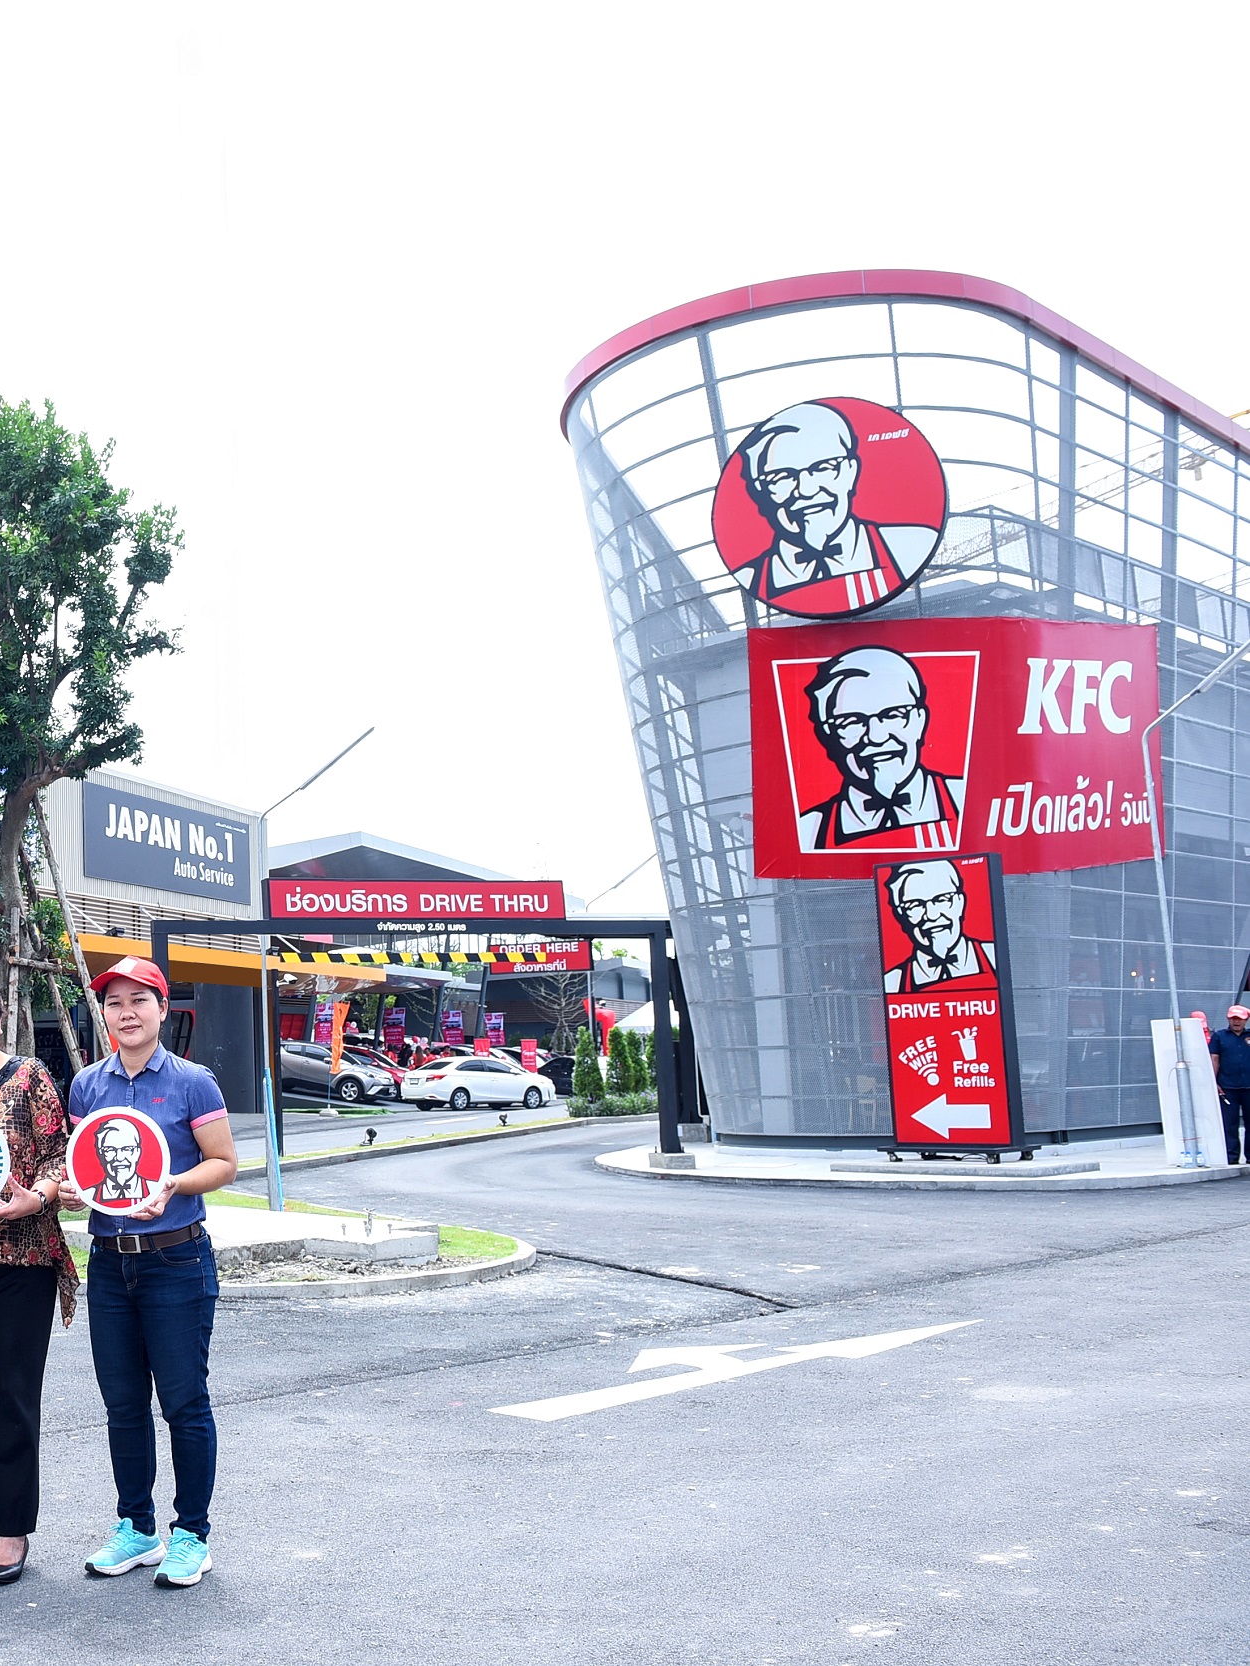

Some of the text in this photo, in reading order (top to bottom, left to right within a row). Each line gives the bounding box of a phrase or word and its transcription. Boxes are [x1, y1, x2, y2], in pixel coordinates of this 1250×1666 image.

[1017, 657, 1134, 735] KFC
[986, 775, 1113, 837] เปิดแล้ว!
[105, 803, 234, 863] JAPAN No.1
[174, 857, 235, 887] Auto Service
[286, 887, 549, 913] ช่องบริการ DRIVE THRU
[376, 922, 466, 933] จำกัดความสูง 2.50 เมตร
[499, 941, 579, 953] ORDER HERE
[513, 958, 567, 972] สังอาหารที่นี่
[888, 1000, 997, 1019] DRIVE THRU
[898, 1035, 937, 1064] FREE
[908, 1050, 938, 1071] WIFI
[953, 1061, 990, 1075] Free
[954, 1075, 996, 1088] Refills
